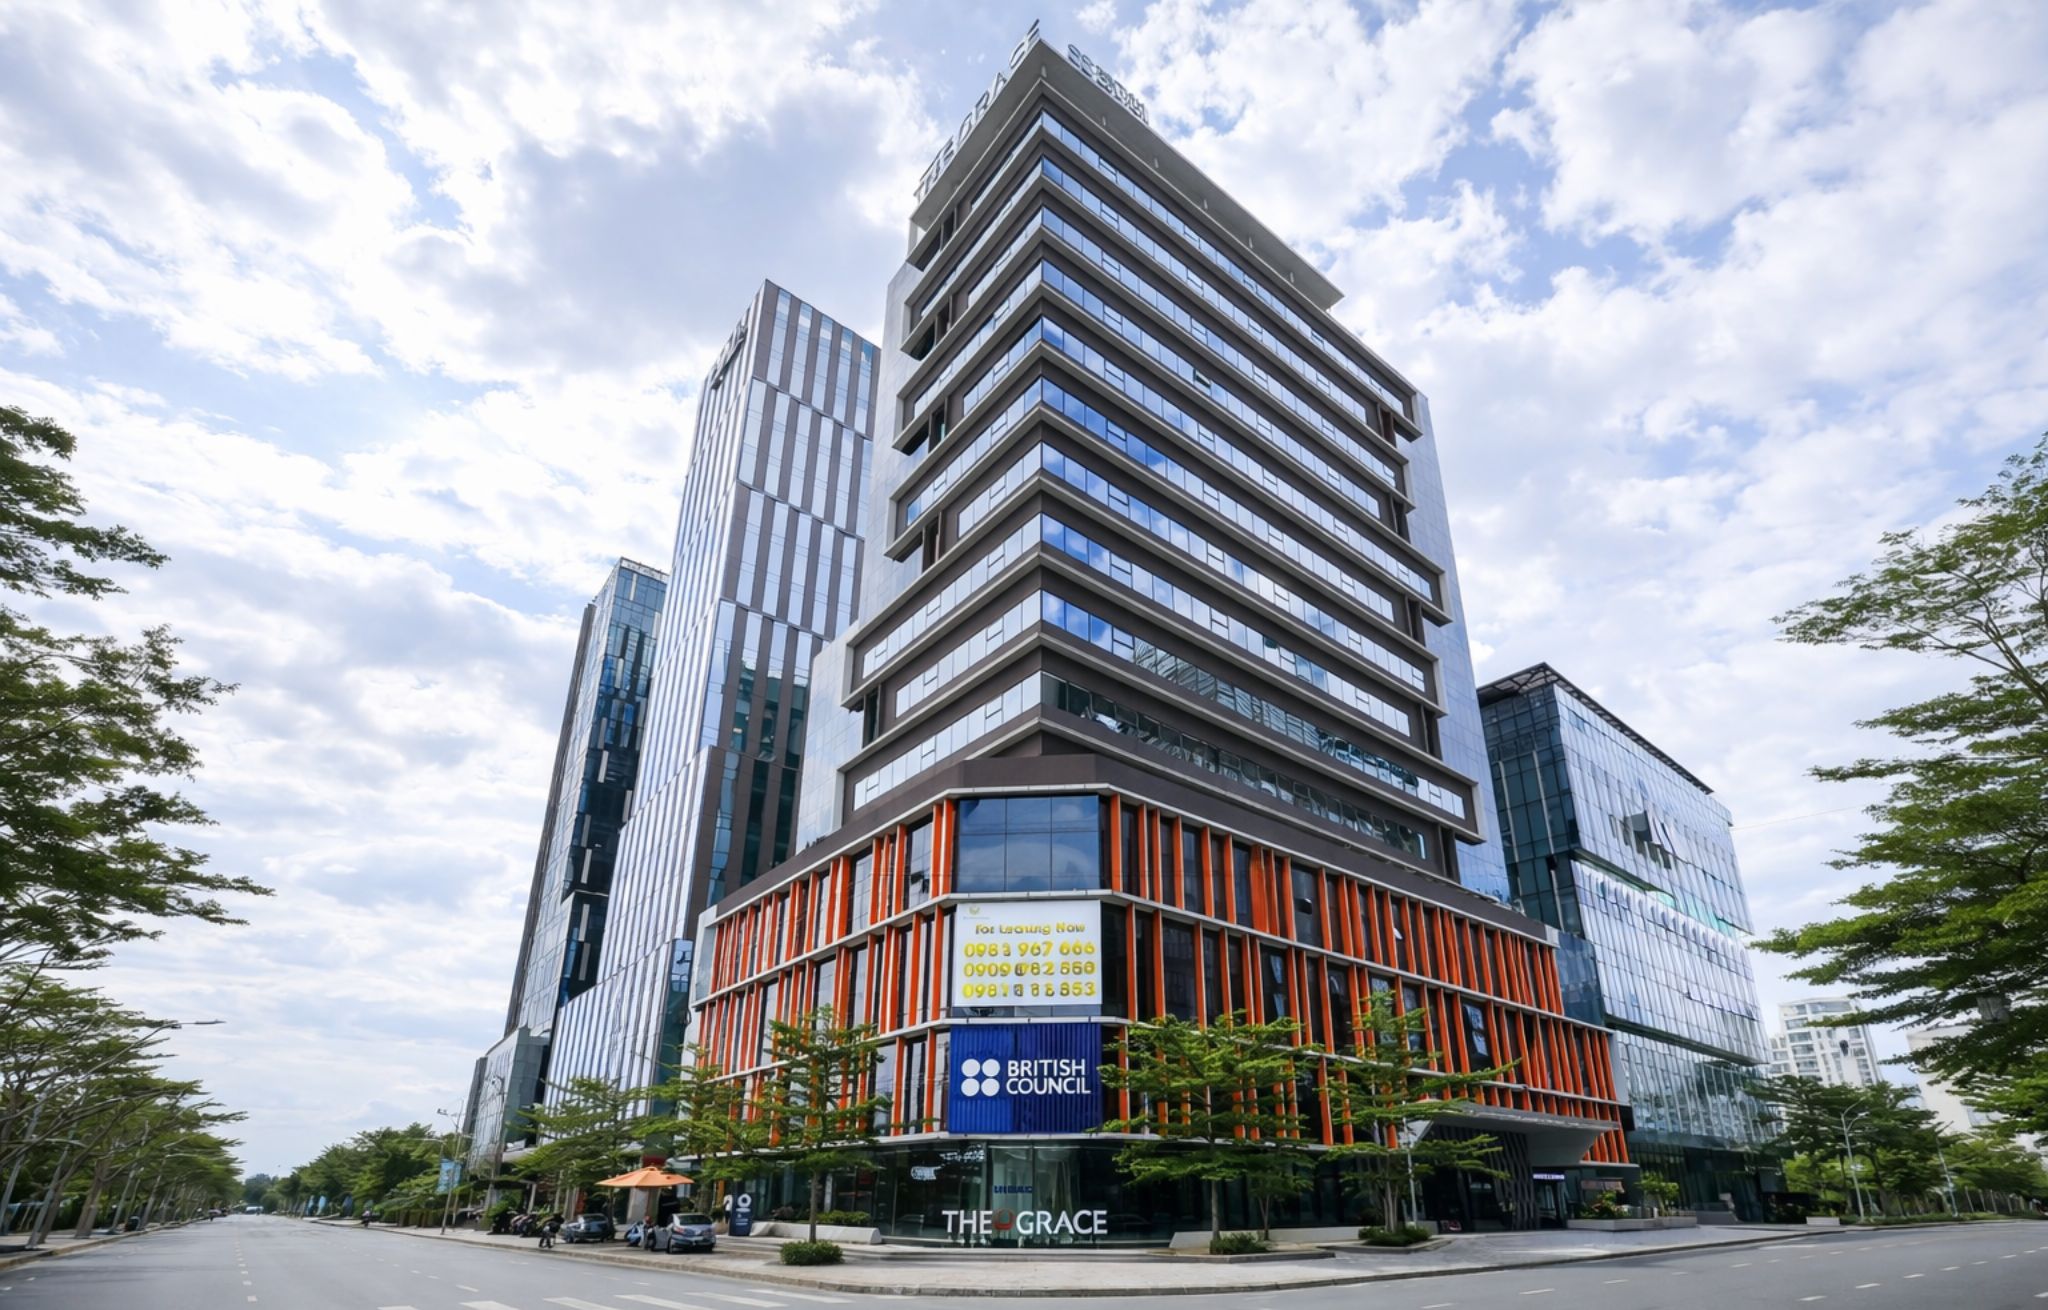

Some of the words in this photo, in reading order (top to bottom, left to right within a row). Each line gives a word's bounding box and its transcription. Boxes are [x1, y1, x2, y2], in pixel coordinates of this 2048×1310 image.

[1008, 1058, 1086, 1077] BRITISH
[1006, 1077, 1091, 1095] COUNCIL
[942, 1210, 993, 1235] THE
[1016, 1210, 1108, 1235] GRACE
